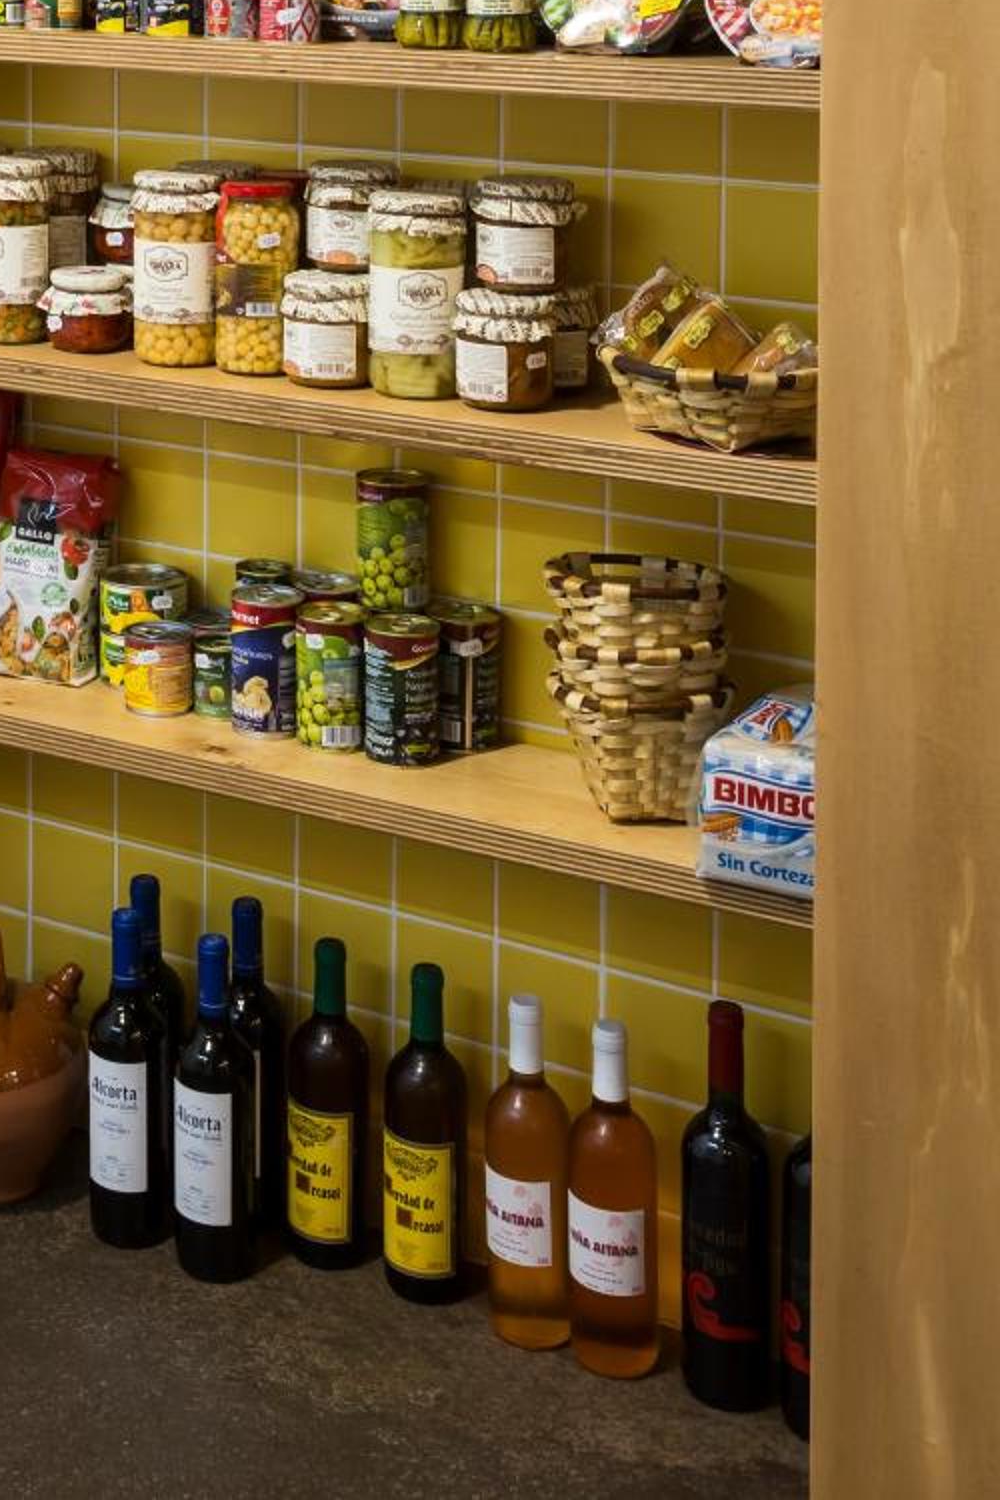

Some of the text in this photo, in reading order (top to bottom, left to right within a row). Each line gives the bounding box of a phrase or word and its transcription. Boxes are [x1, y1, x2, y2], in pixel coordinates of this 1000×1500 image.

[17, 527, 54, 541] GALLO
[717, 851, 745, 872] Sin
[92, 1076, 138, 1102] Alcorta
[177, 1104, 222, 1132] Alcorta
[501, 1209, 545, 1230] AITANA
[593, 1241, 640, 1259] AITANA
